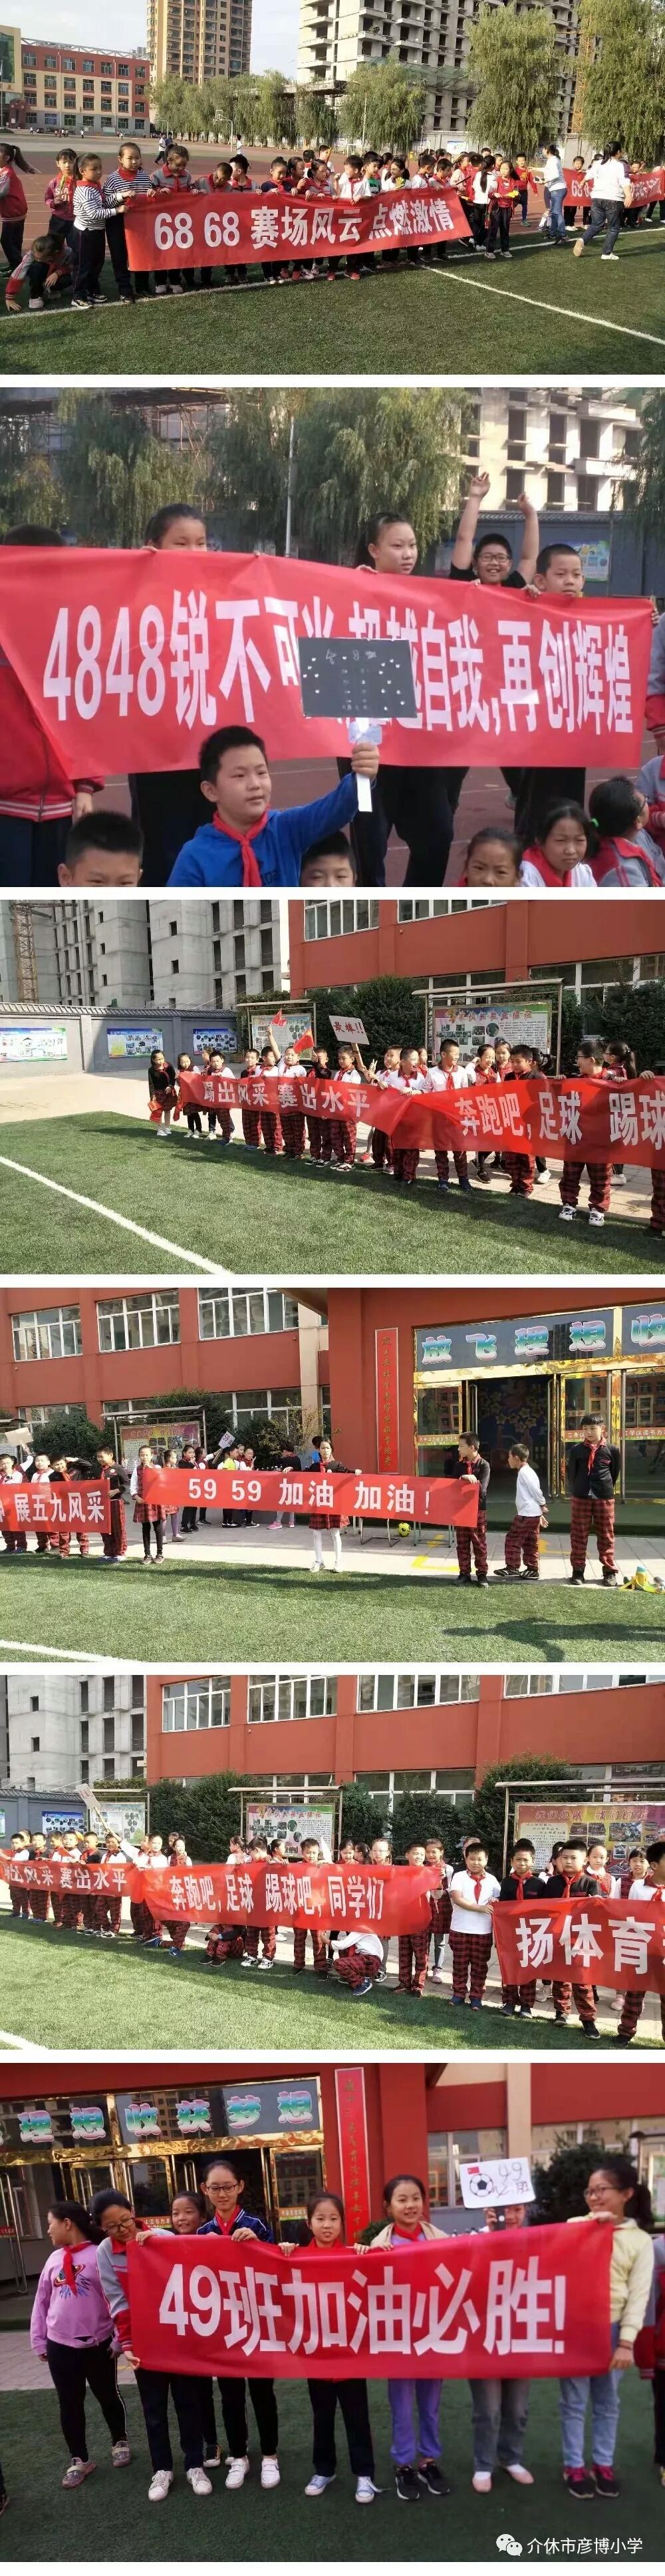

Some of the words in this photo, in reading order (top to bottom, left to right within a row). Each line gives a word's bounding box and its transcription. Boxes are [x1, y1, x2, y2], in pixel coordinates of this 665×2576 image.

[154, 212, 194, 251] 68
[203, 210, 240, 248] 68
[250, 205, 362, 250] 赛场风云
[368, 197, 455, 240] 点燃激情
[277, 1082, 370, 1117] 赛出水平
[608, 1089, 665, 1151] 踢球
[14, 1491, 104, 1523] 展五九风采
[188, 1478, 217, 1500] 59
[231, 1479, 262, 1503] 59
[278, 1477, 333, 1509] 加油
[354, 1481, 430, 1515] 加油!
[60, 1867, 128, 1892] 赛出水平
[515, 1913, 665, 1974] 扬体育
[0, 2090, 313, 2143] 理想收获梦想
[499, 2161, 522, 2182] 49
[159, 2255, 567, 2356] 49班加油必胜!
